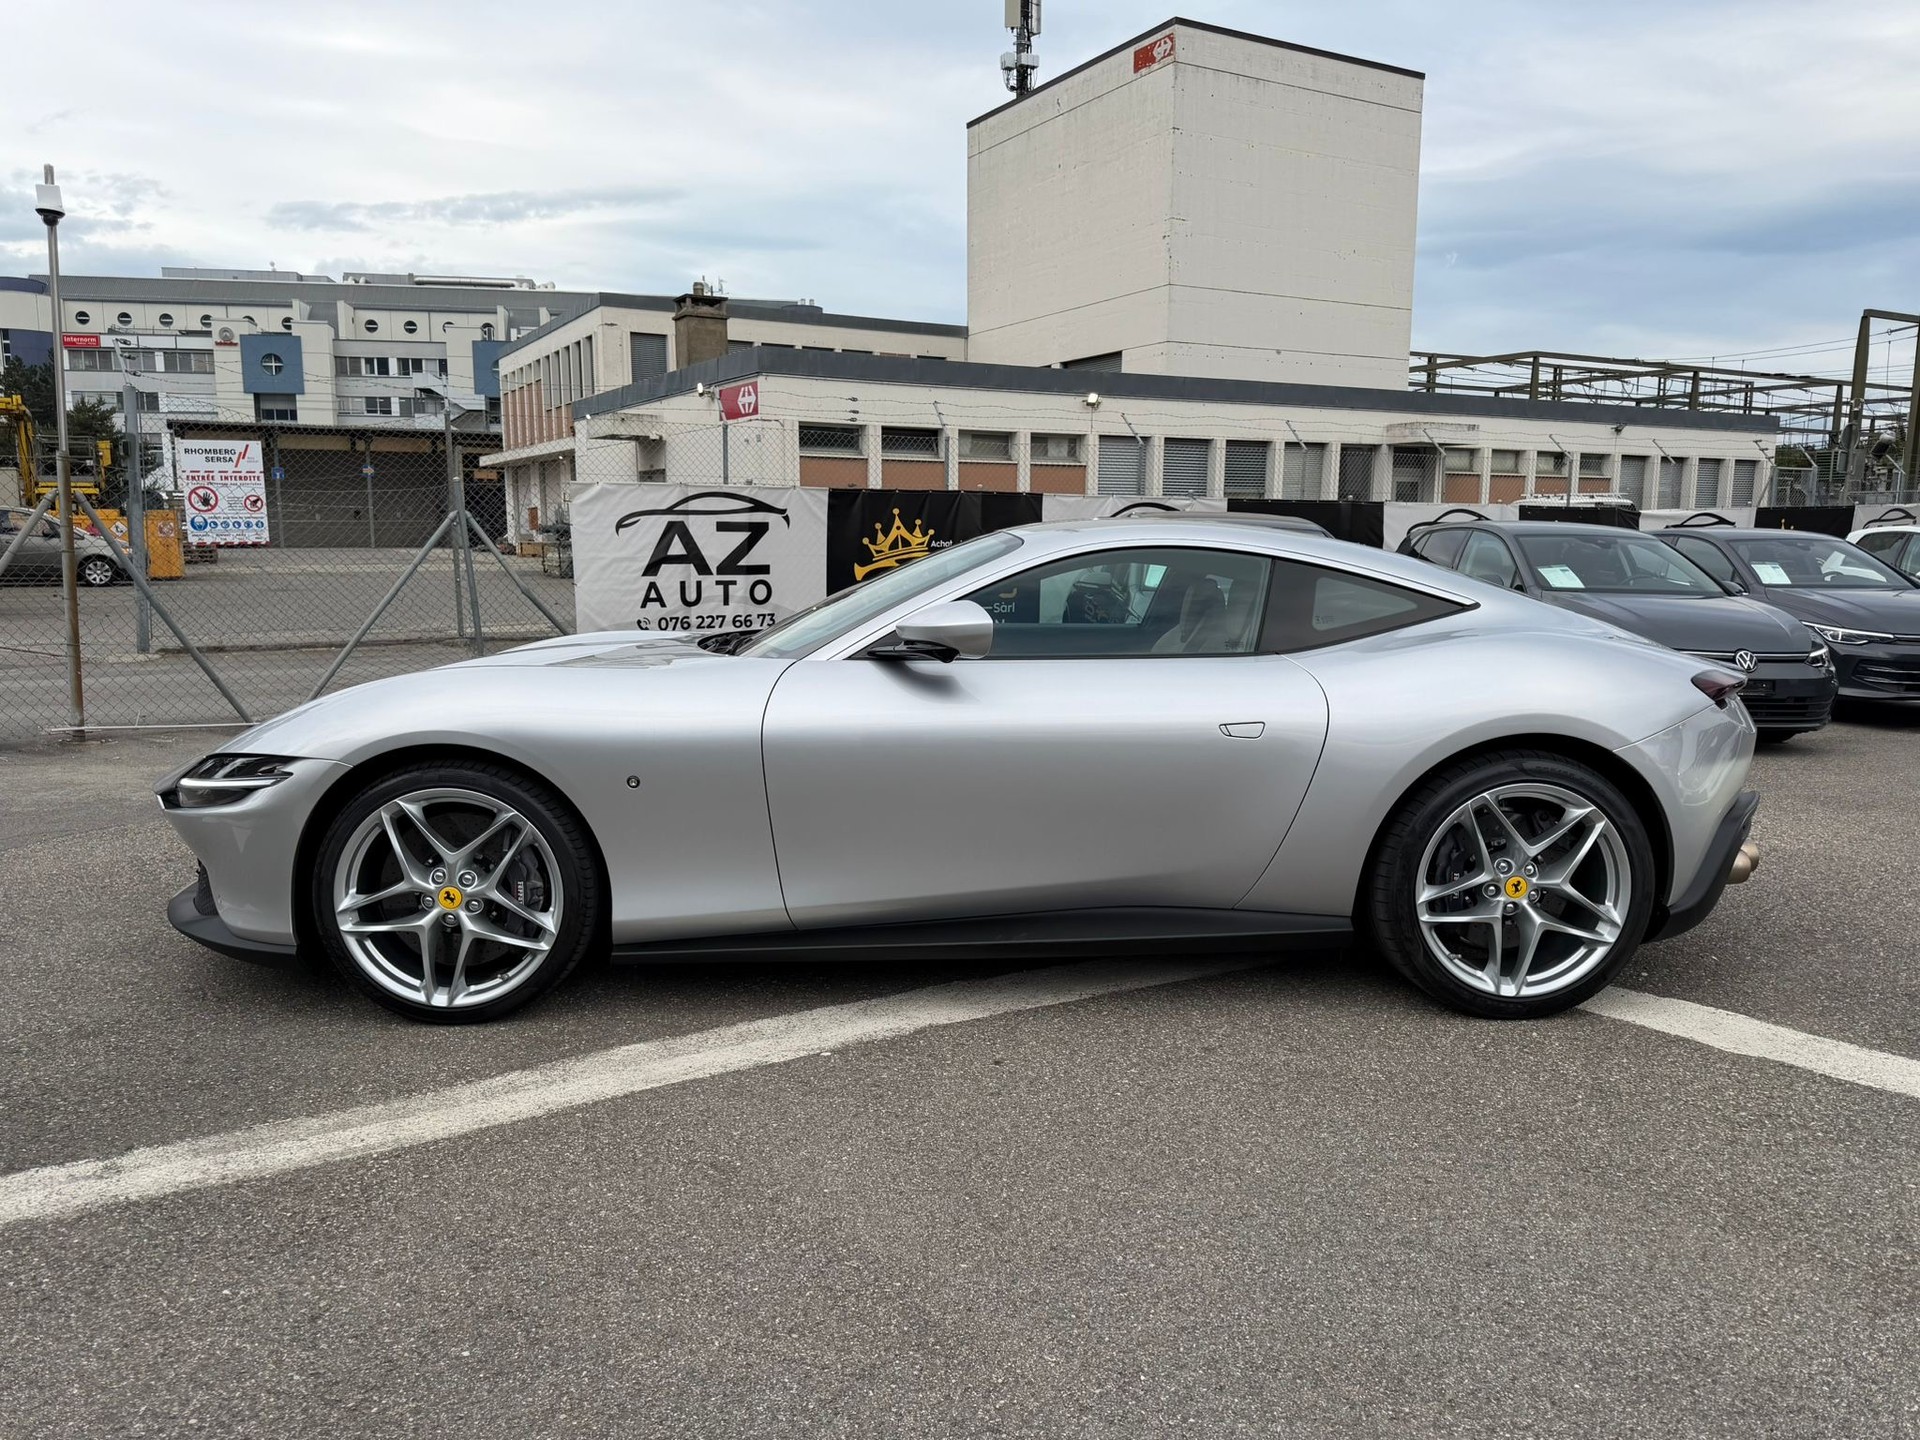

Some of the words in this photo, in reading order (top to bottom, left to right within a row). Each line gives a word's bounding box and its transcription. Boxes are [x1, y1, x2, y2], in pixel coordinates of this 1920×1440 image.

[641, 520, 770, 576] AZ
[640, 579, 772, 608] AUTO
[658, 616, 691, 631] 076
[695, 615, 726, 629] 227
[732, 614, 753, 628] 66
[757, 613, 776, 627] 73
